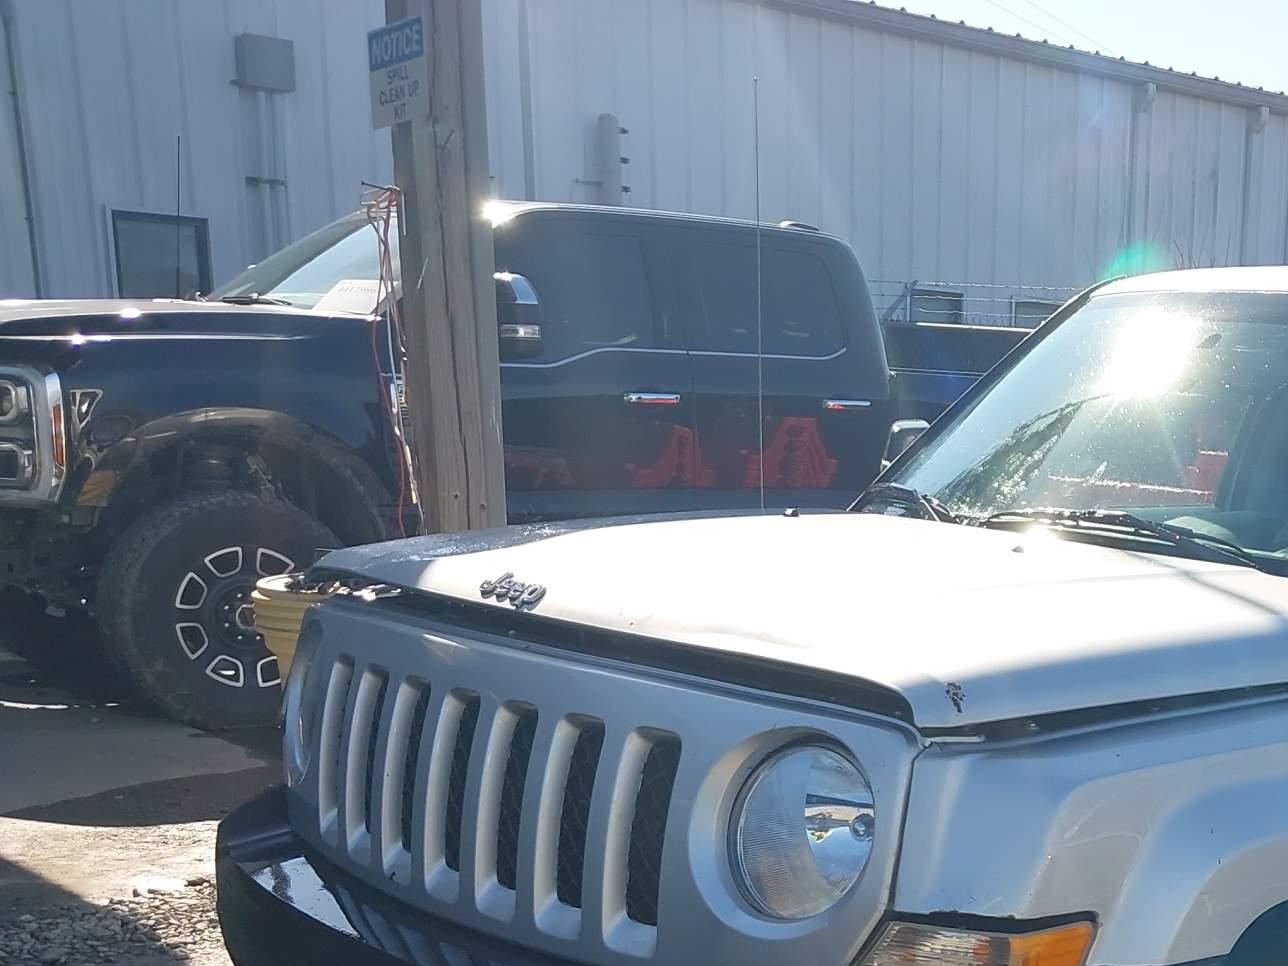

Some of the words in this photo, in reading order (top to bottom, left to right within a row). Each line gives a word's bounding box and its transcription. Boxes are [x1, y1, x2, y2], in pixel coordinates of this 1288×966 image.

[371, 24, 421, 65] NOTICE
[386, 64, 409, 84] SPILL
[379, 84, 406, 106] CLEAN
[407, 80, 420, 98] UP
[393, 103, 408, 121] KIT
[480, 572, 546, 611] Jeep
